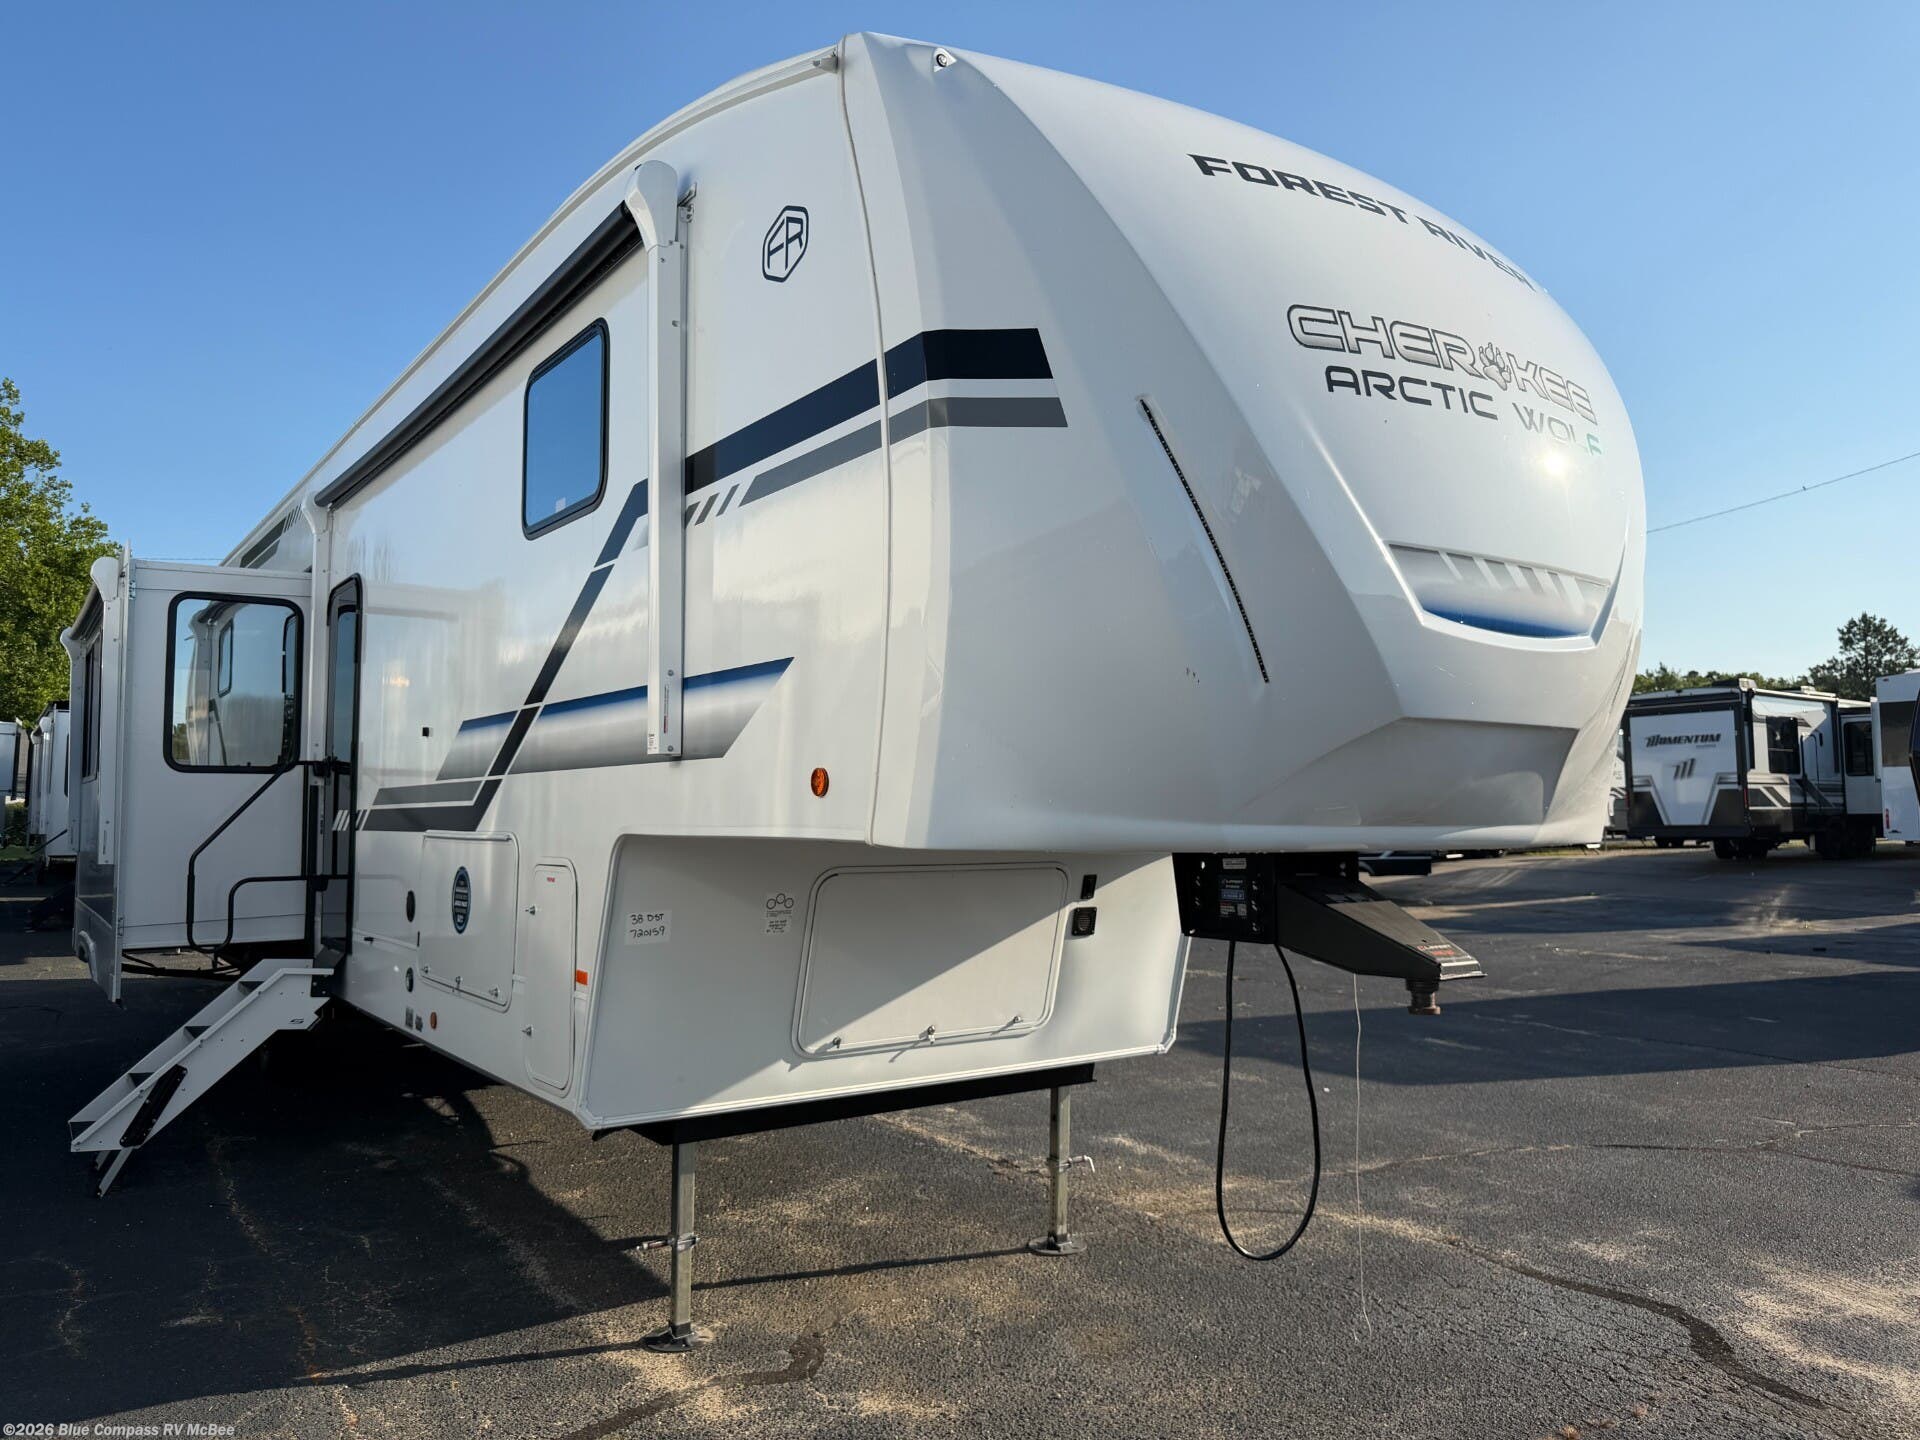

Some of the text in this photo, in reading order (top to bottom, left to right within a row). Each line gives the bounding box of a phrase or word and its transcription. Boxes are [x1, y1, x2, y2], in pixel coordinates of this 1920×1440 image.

[1187, 154, 1536, 292] FOREST RIVER
[1325, 366, 1602, 456] ARCTIC WOLF
[1645, 733, 1721, 748] MOMENTUM
[630, 914, 644, 925] 38
